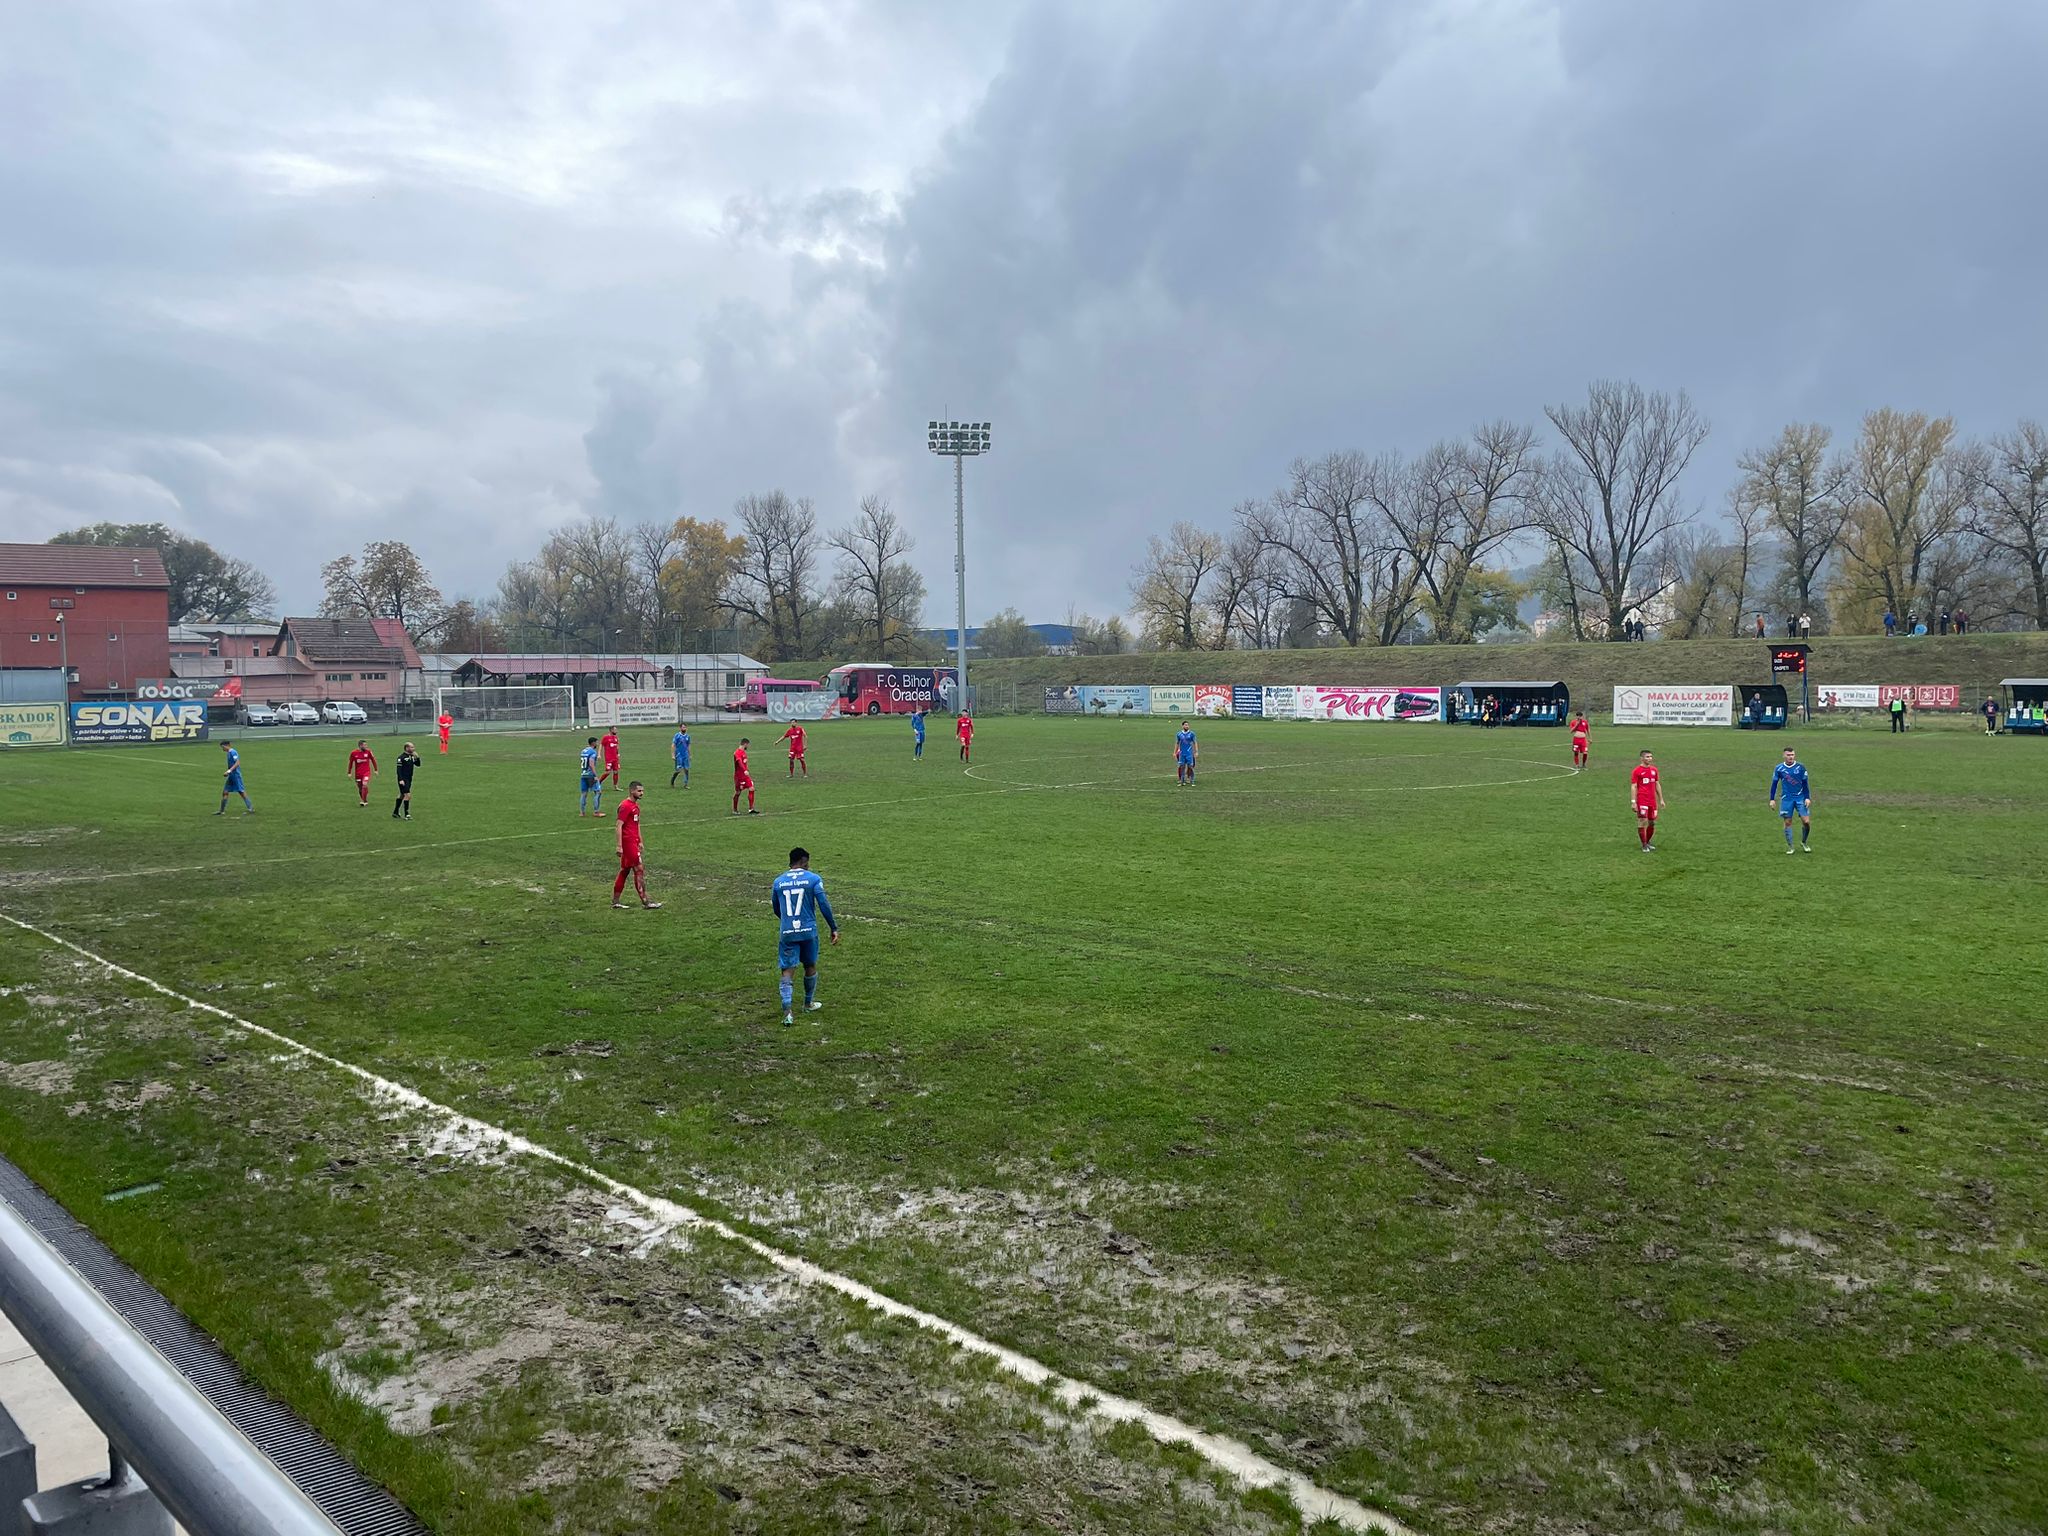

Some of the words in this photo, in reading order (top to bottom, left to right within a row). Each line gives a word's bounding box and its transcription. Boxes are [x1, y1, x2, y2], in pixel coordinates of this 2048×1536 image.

[877, 674, 900, 688] F.C.
[903, 674, 931, 688] Bihor
[892, 687, 931, 702] Oradea
[1154, 691, 1191, 699] LABRADOR
[1196, 687, 1208, 697] OK
[1647, 692, 1680, 701] MAYA
[1681, 692, 1701, 701] LUX
[1705, 692, 1729, 701] 2012
[614, 697, 637, 705] MAYA
[657, 696, 675, 704] 2012
[75, 703, 205, 727] SONAR
[150, 724, 203, 741] BET
[782, 887, 805, 917] 17
